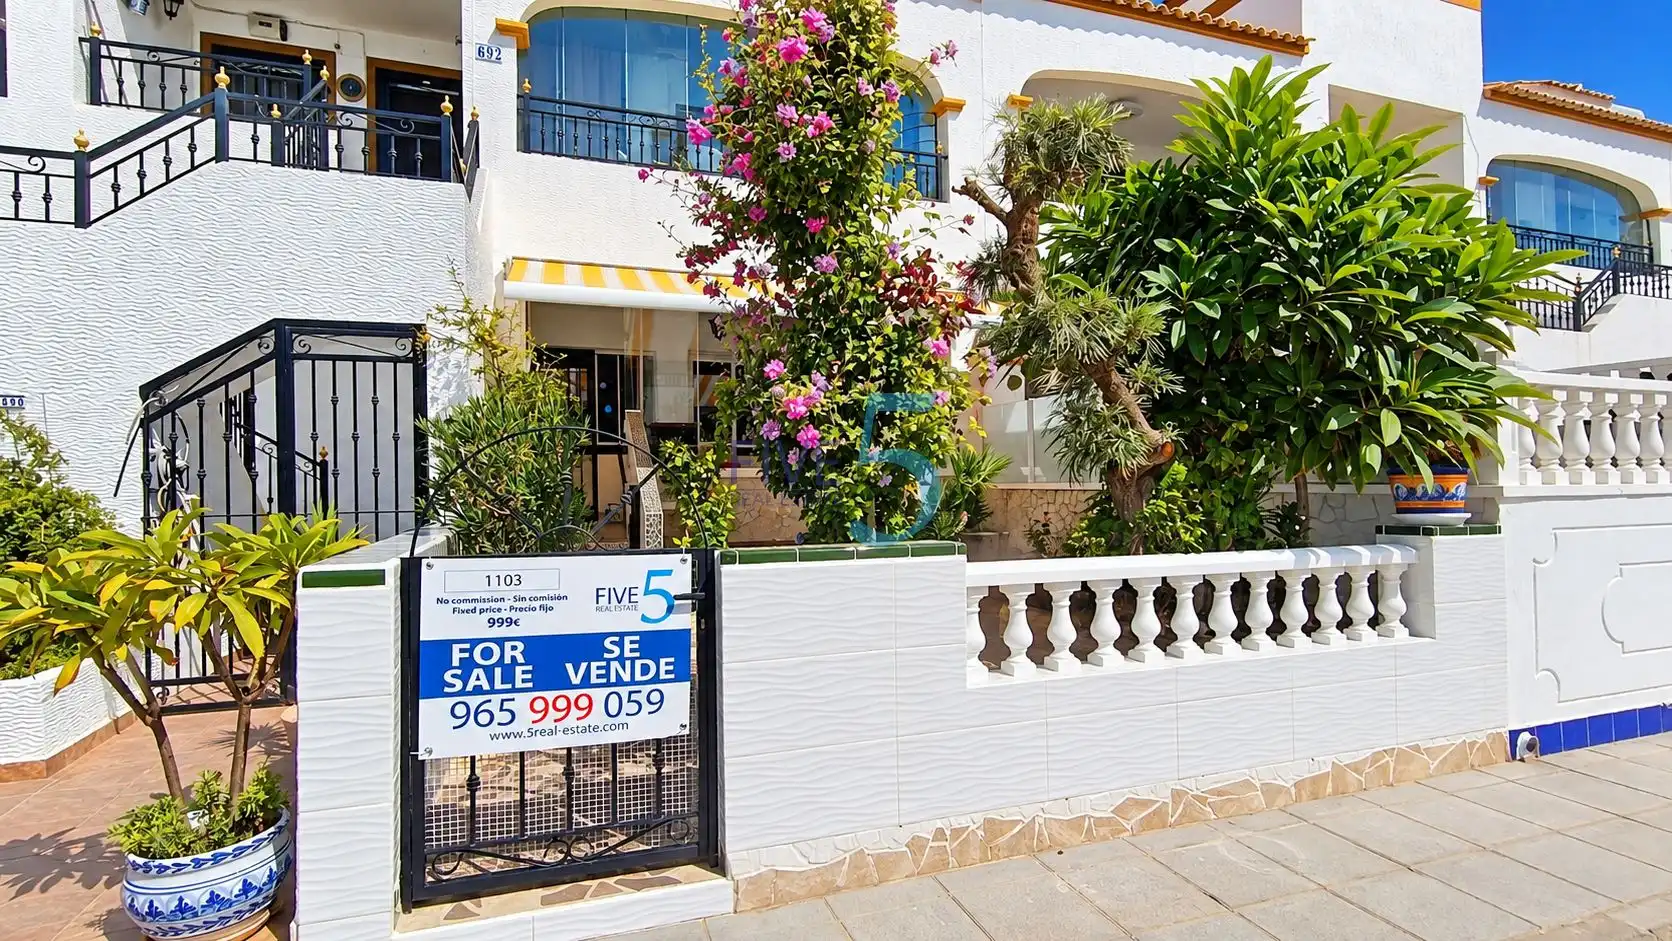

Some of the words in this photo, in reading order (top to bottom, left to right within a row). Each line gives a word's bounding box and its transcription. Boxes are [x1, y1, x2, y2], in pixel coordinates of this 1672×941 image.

[477, 45, 502, 60] 692
[484, 574, 523, 588] 1103
[436, 596, 450, 606] No
[451, 595, 505, 604] commission
[512, 594, 528, 603] Sin
[529, 592, 568, 602] comisión
[595, 586, 639, 605] FIVE
[640, 569, 676, 624] 5
[452, 606, 477, 615] Fixed
[479, 606, 502, 617] price
[509, 604, 537, 613] Precio
[538, 604, 555, 615] fijo
[595, 605, 612, 613] REAL
[613, 604, 639, 612] ESTATE
[487, 617, 521, 628] 999€
[451, 641, 526, 667] FOR
[603, 635, 641, 659] SE
[443, 665, 534, 693] SALE
[565, 657, 676, 685] VENDE
[450, 697, 517, 730] 965
[529, 693, 594, 724] 999
[603, 688, 665, 718] 059
[489, 720, 629, 741] www.5real-estate.com
